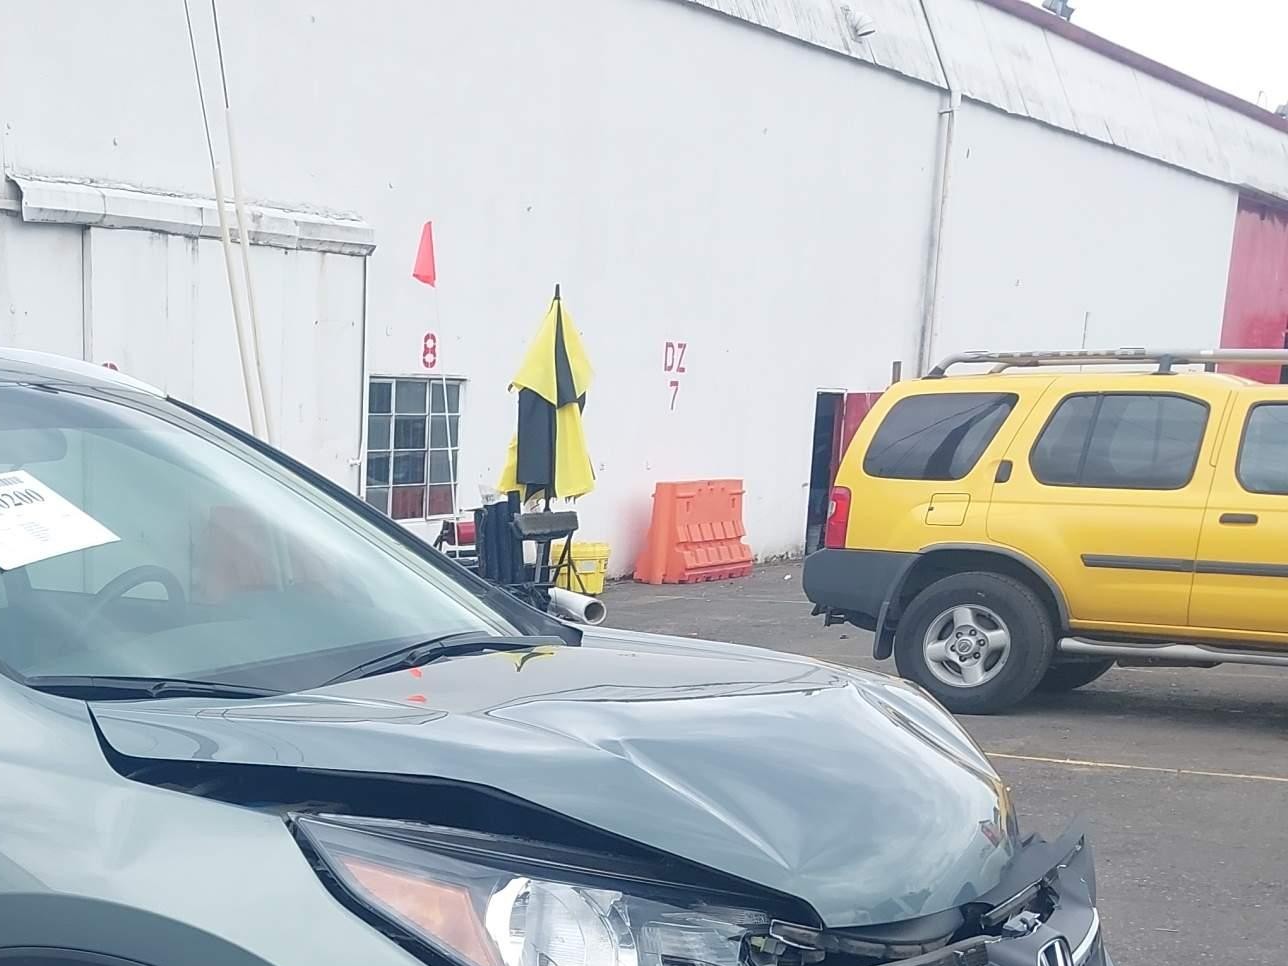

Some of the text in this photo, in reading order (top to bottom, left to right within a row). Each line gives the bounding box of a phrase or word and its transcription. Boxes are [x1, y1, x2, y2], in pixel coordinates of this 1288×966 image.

[422, 332, 438, 369] 8
[664, 341, 687, 373] DZ
[669, 380, 680, 411] 7
